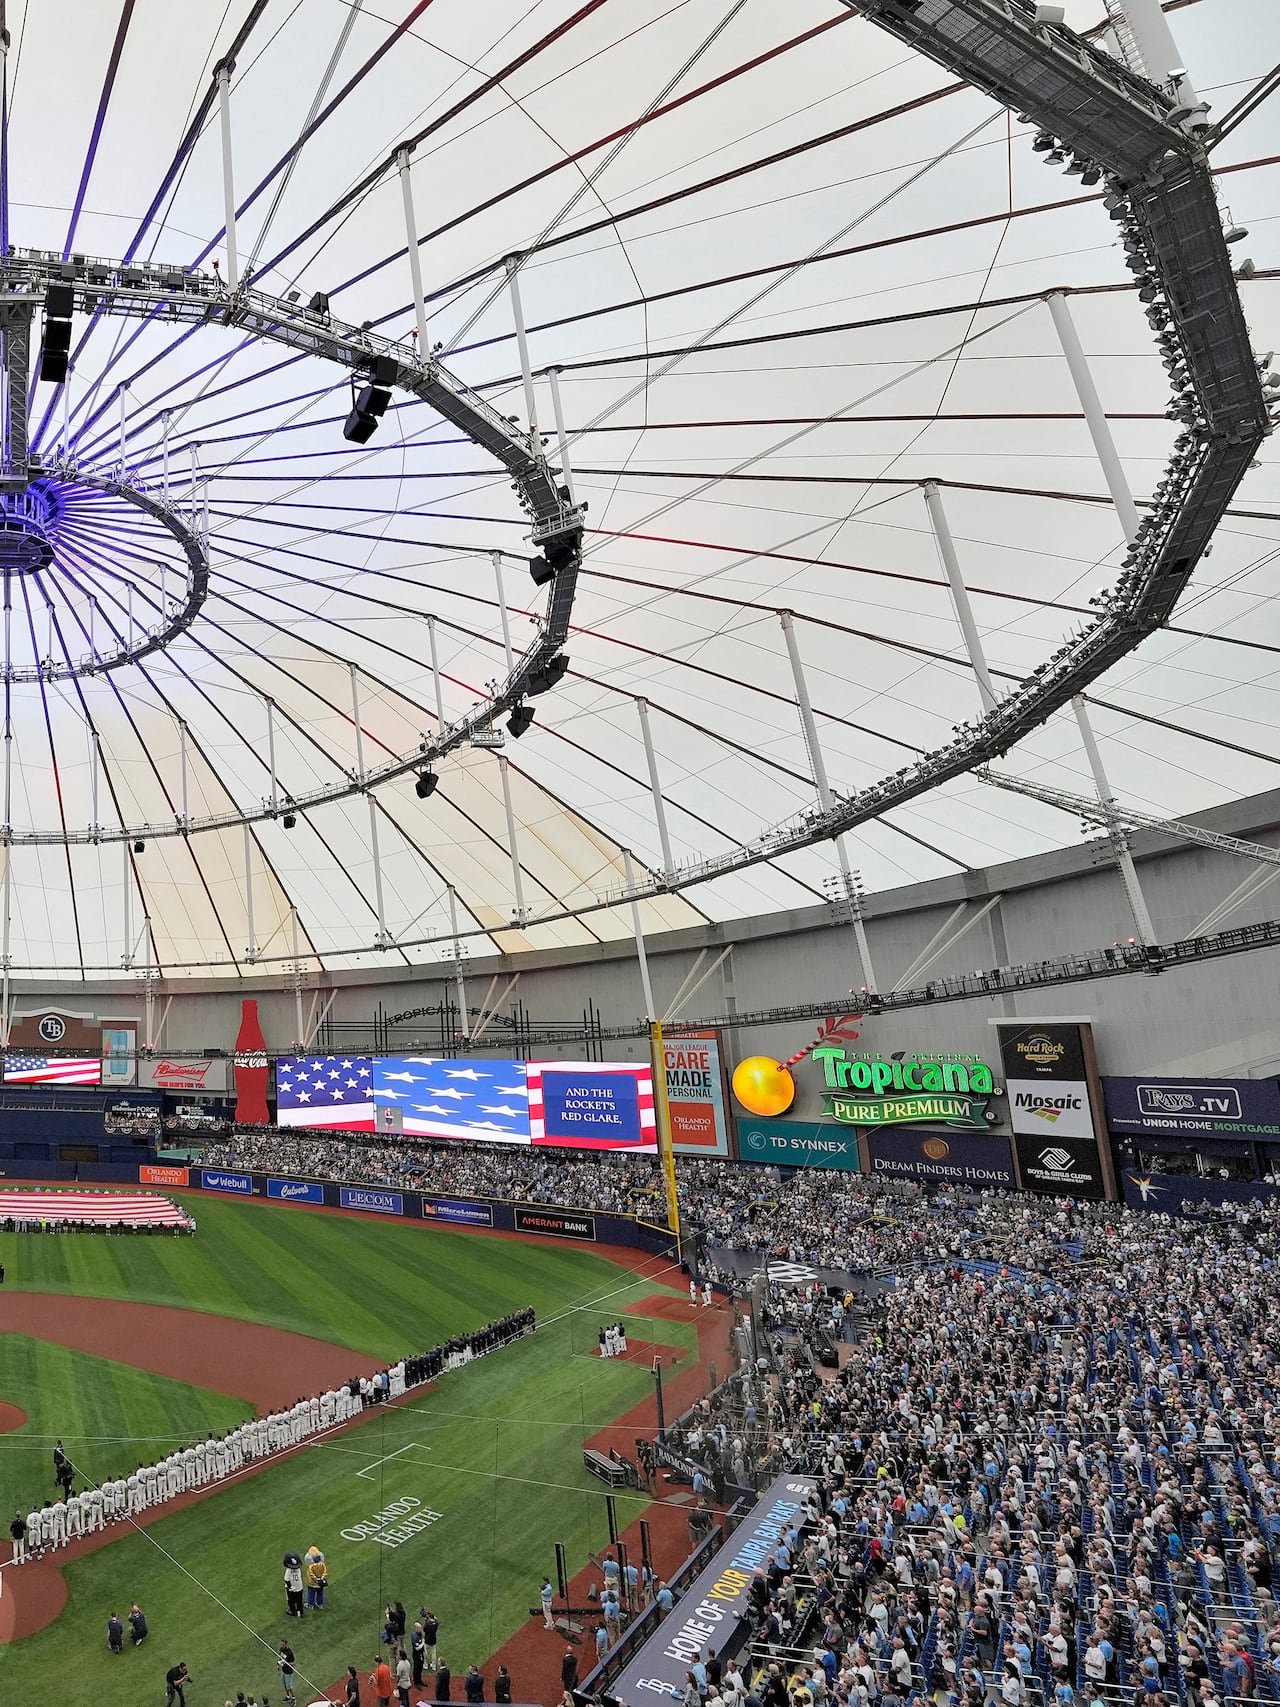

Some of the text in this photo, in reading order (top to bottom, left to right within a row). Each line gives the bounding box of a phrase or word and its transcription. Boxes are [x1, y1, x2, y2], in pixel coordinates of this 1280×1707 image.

[1017, 1043, 1065, 1054] Hard Rock
[664, 1051, 710, 1070] CARE
[911, 1053, 981, 1061] ORIGINAL
[813, 1047, 992, 1095] Tropicana
[665, 1070, 713, 1088] MADE
[565, 1087, 614, 1098] AND THE
[667, 1087, 713, 1098] PERSONAL
[565, 1100, 616, 1111] ROCKET'S
[1015, 1092, 1081, 1110] Mosaic
[561, 1111, 582, 1121] RED
[833, 1100, 970, 1120] PURE PREMIUM
[673, 1115, 711, 1124] ORLANDO
[678, 1122, 708, 1131] HEALTH
[1142, 1118, 1178, 1128] UNION
[1179, 1120, 1212, 1130] HOME
[1214, 1122, 1280, 1134] MORTGAGE
[770, 1136, 847, 1153] TD SYNNEX
[147, 1167, 182, 1177] ORLANDO
[874, 1158, 1010, 1182] DREAM FINDERS HOMES
[151, 1174, 178, 1184] HEALTH
[220, 1177, 247, 1190] Webull
[348, 1192, 394, 1207] LECOM
[522, 1215, 587, 1232] AMERANT BANK
[340, 1496, 421, 1541] ORLANDO
[371, 1508, 444, 1548] HEALTH
[663, 1499, 800, 1664] HOME OF YOUR TAMPA BAY RAYS
